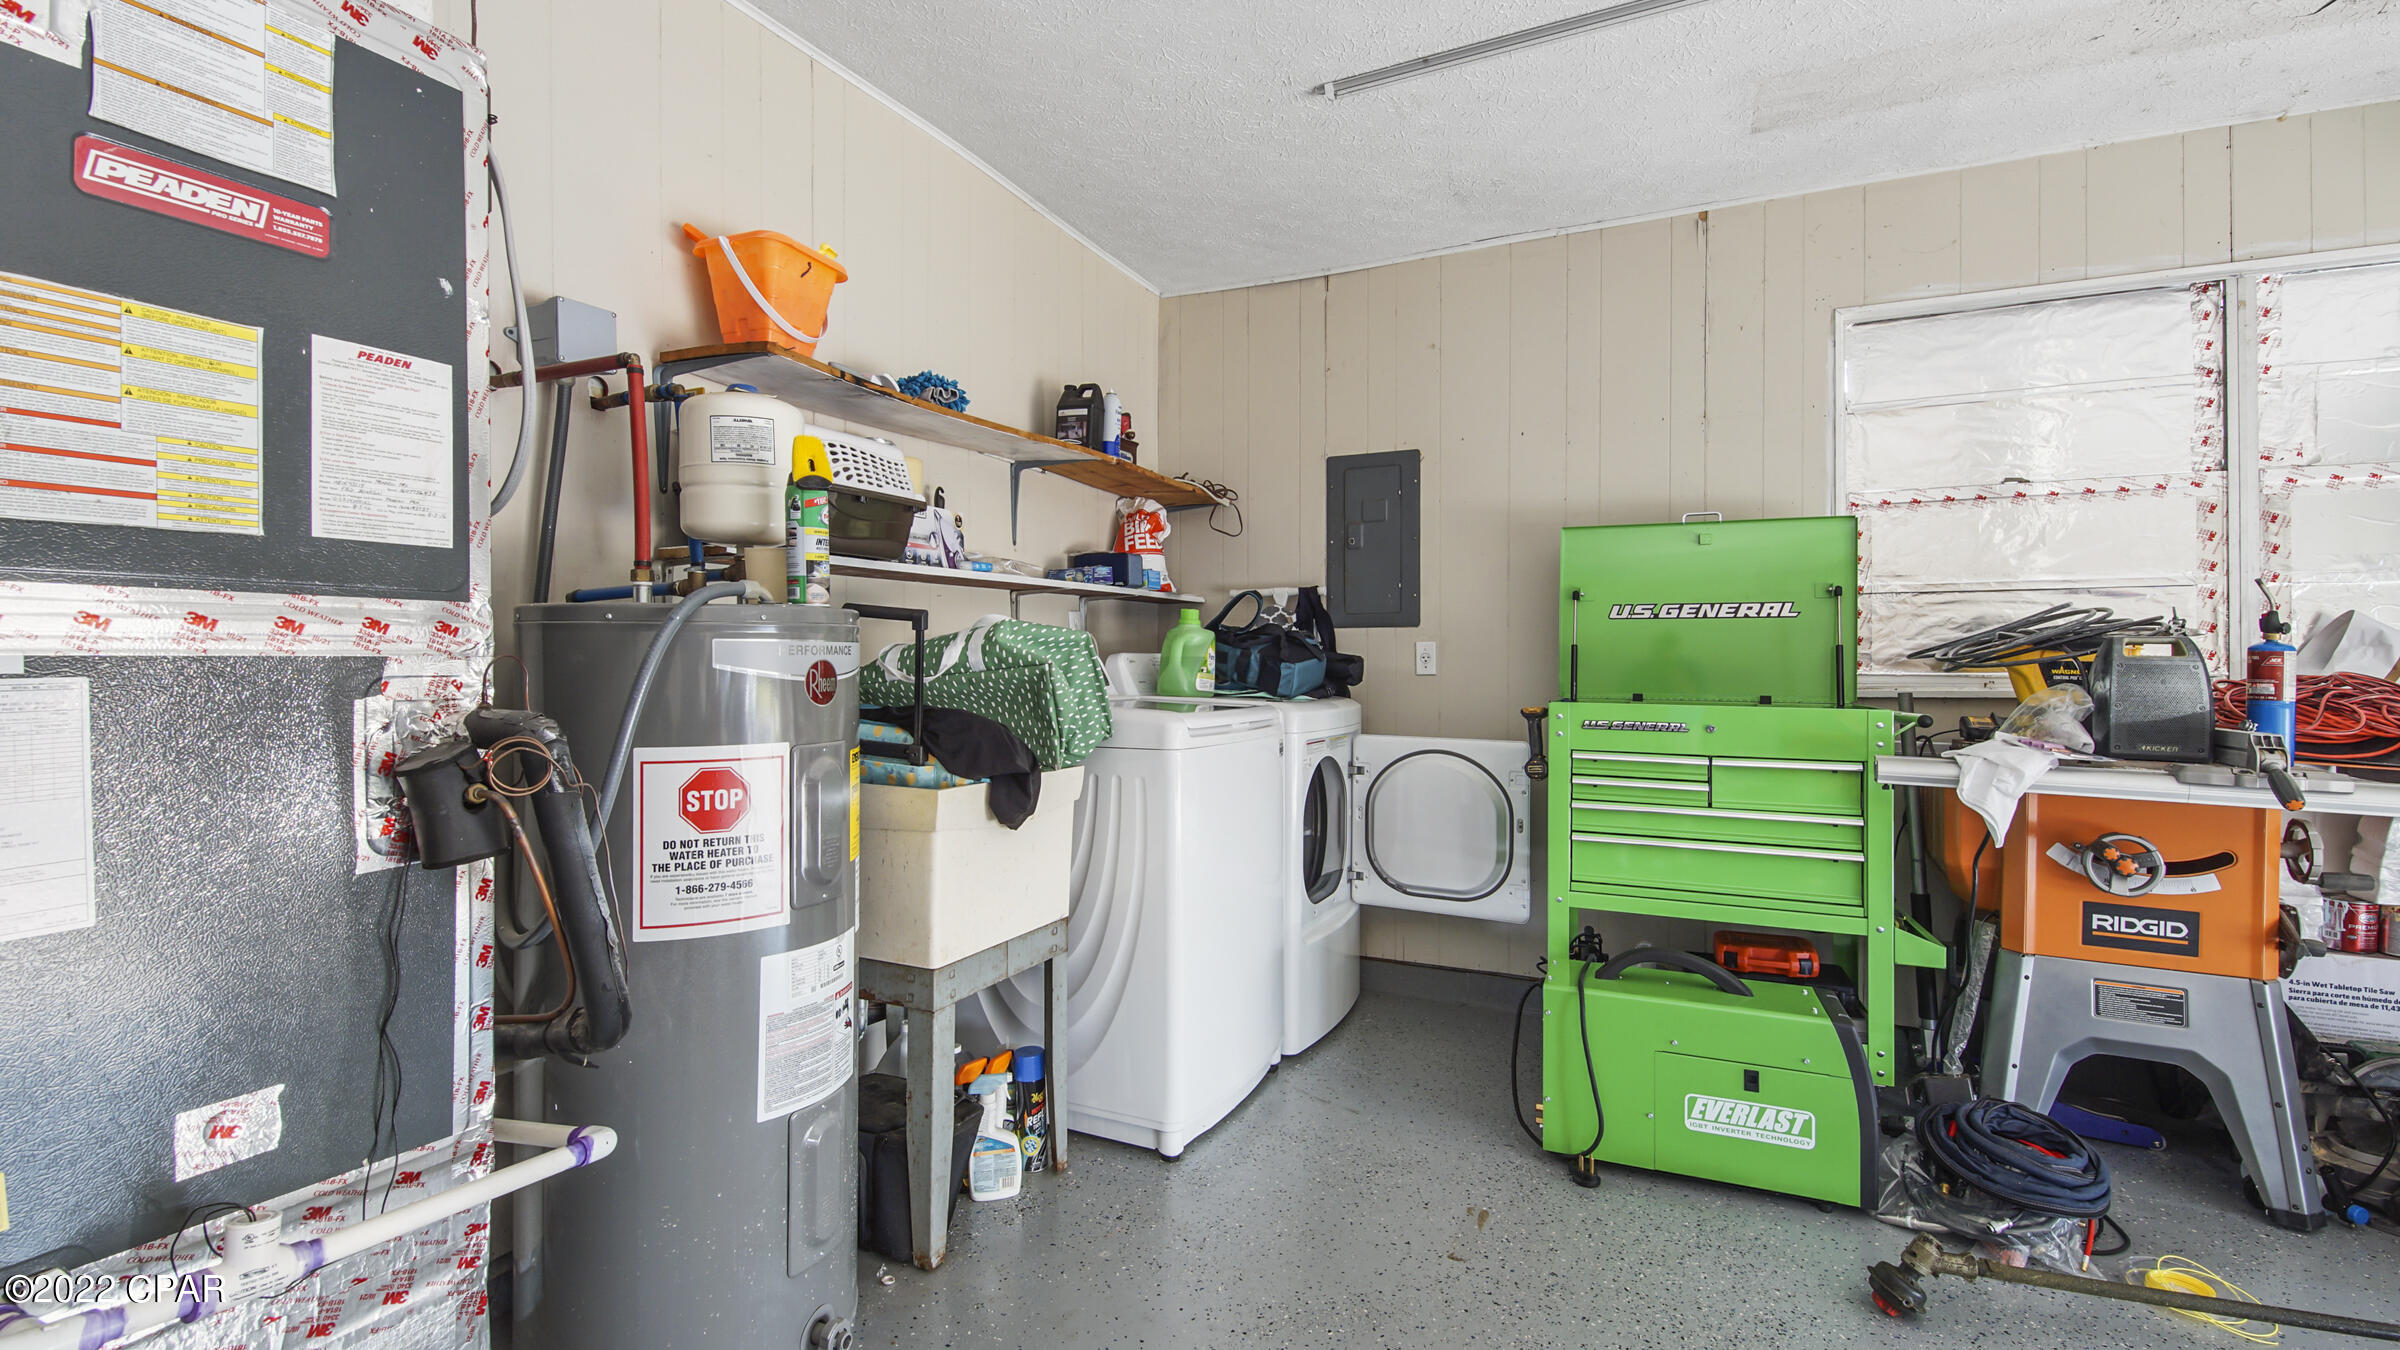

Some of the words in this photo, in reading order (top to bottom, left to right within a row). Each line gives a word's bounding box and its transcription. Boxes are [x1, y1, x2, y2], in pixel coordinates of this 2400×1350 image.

[412, 35, 439, 61] 3M
[94, 156, 261, 221] PEADEN
[211, 210, 227, 220] PRO
[228, 214, 254, 227] SERIES
[272, 214, 315, 231] WARRANTY
[301, 215, 324, 228] PARTS
[357, 350, 412, 369] PEADEN
[195, 441, 223, 450] CAUTION
[195, 475, 231, 486] ATTENTION
[195, 493, 223, 502] CAUTION
[195, 516, 231, 525] ATTENTION
[283, 600, 306, 613] COLD
[307, 608, 344, 627] WEATHER
[441, 606, 460, 618] COLD
[73, 610, 112, 632] 3M
[183, 611, 219, 632] 3M
[273, 615, 306, 636] 3M
[361, 616, 390, 636] 3M
[434, 620, 460, 638] 3M
[352, 640, 383, 656] 181B-FX
[426, 642, 453, 657] 181B-FX
[428, 636, 452, 650] 181A-P
[785, 644, 852, 656] ERFORMANCE
[809, 660, 836, 699] Rheem
[378, 751, 397, 777] 3M
[686, 788, 744, 812] STOP
[663, 840, 677, 850] DO
[679, 839, 700, 849] NOT
[702, 836, 742, 848] RETURN
[745, 834, 766, 846] THIS
[669, 850, 705, 861] WATER
[707, 847, 745, 859] HEATER
[747, 845, 759, 855] TO
[652, 863, 671, 873] THE
[674, 860, 707, 872] PLACE
[709, 860, 723, 870] OF
[725, 854, 775, 868] PURCHASE
[475, 879, 493, 902] 3M
[675, 879, 754, 895] 1-866-279-4566
[2092, 913, 2189, 938] RIDGID
[475, 944, 493, 968] 3M
[2289, 979, 2311, 988] 4.5-in
[2311, 981, 2328, 989] Wet
[2329, 983, 2363, 993] Tabletop
[2363, 987, 2378, 995] Tile
[2379, 988, 2396, 996] Saw
[2289, 987, 2311, 996] Sierra
[2312, 990, 2330, 999] para
[2330, 992, 2351, 1000] corte
[2362, 994, 2392, 1005] húmedo
[2289, 995, 2306, 1003] para
[2306, 996, 2338, 1006] cubierta
[2339, 998, 2348, 1007] de
[2349, 1001, 2369, 1009] mesa
[2370, 1002, 2380, 1010] de
[473, 1006, 491, 1031] 3M
[473, 1080, 491, 1105] 3M
[1690, 1098, 1810, 1135] EVERLAST
[1689, 1122, 1709, 1130] IGBT
[1711, 1126, 1752, 1137] INVERTER
[1755, 1132, 1812, 1146] TECHNOLOGY
[470, 1142, 488, 1166] 3M
[395, 1171, 423, 1185] 3M
[302, 1205, 333, 1221] 3M
[464, 1223, 488, 1237] 3M
[420, 1239, 449, 1248] WEATHER
[126, 1254, 154, 1265] COLD
[154, 1253, 197, 1264] WEATHER
[457, 1256, 481, 1270] 3M
[391, 1268, 418, 1276] 181B-FX
[396, 1282, 414, 1290] 3340
[381, 1290, 409, 1306] 3M
[305, 1322, 336, 1339] 3M
